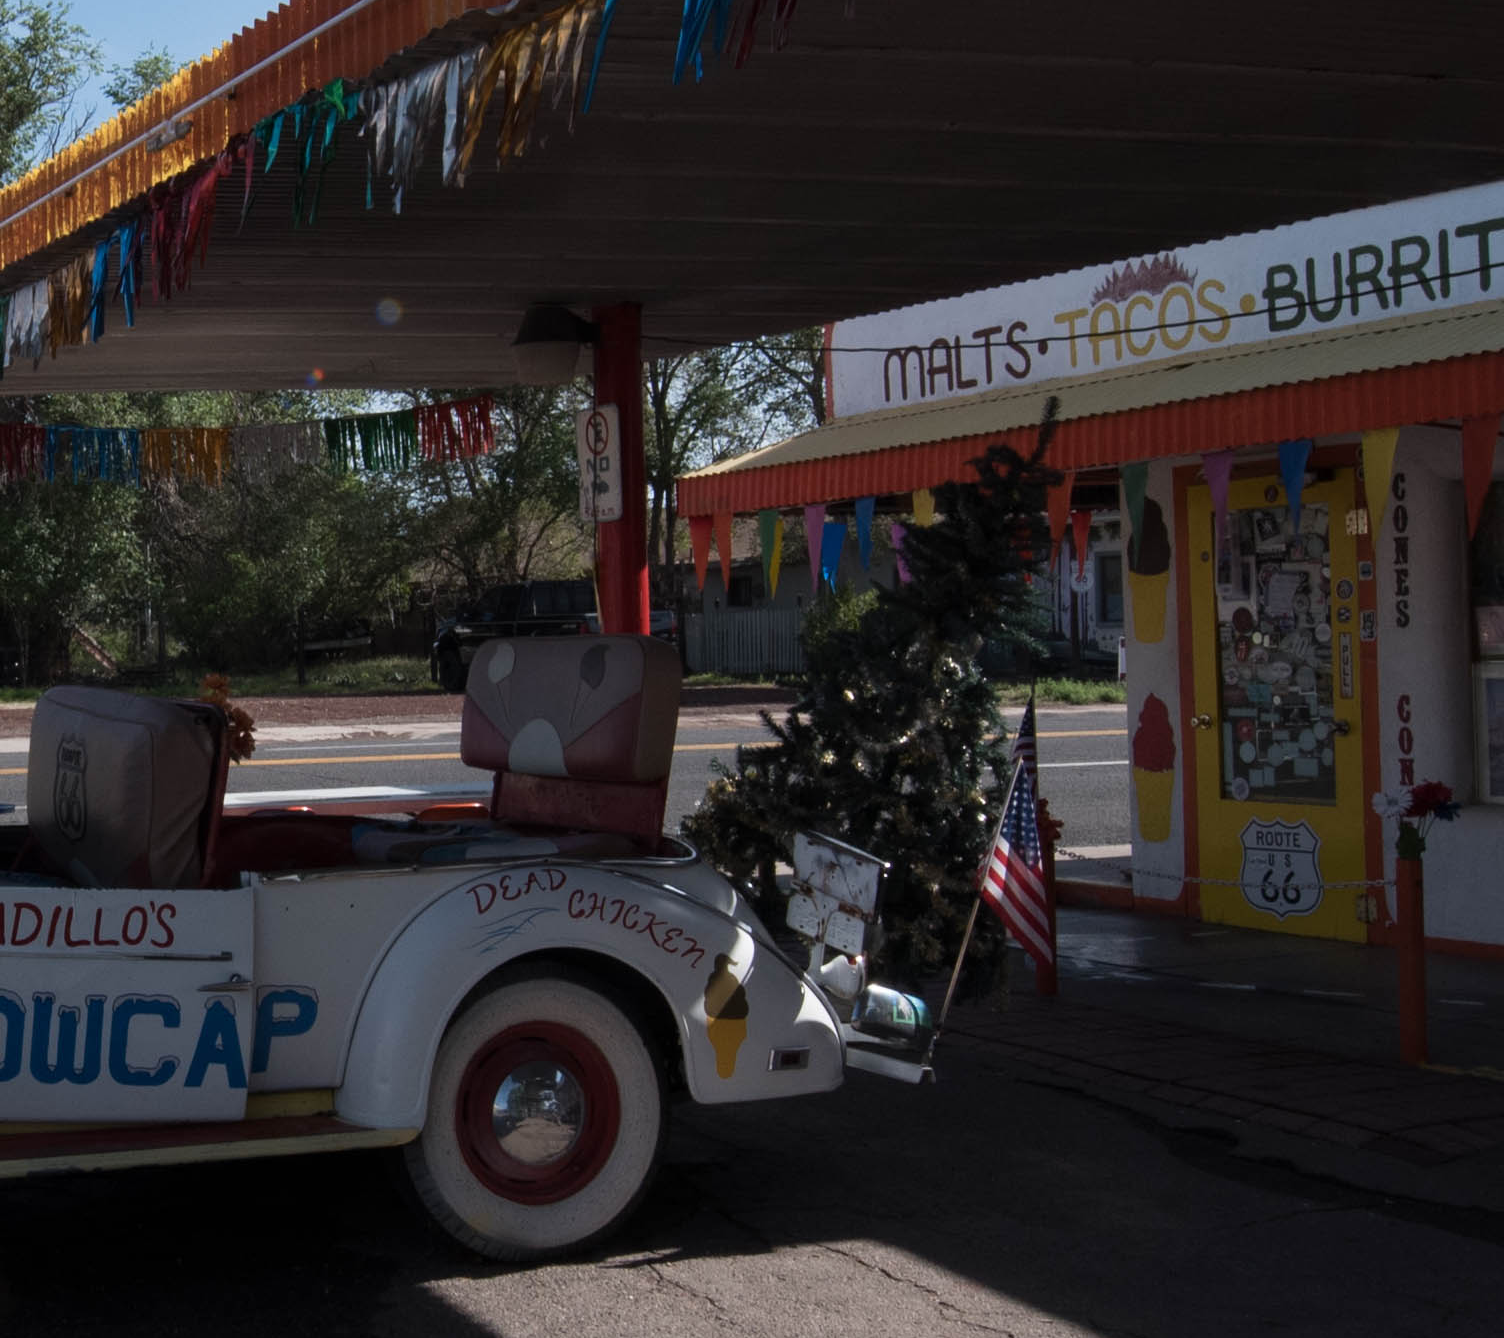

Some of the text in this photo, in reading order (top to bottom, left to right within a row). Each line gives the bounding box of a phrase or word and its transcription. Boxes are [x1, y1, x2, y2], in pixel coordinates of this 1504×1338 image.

[884, 321, 1032, 402] MALTS
[1055, 279, 1231, 368] TACOS
[1392, 472, 1410, 629] CONES
[1342, 645, 1352, 688] PULL
[1397, 695, 1414, 786] CON
[58, 772, 83, 832] 66
[1255, 830, 1302, 848] ROUTE
[467, 868, 705, 969] DEAD CHICKEN
[1260, 869, 1302, 905] 66
